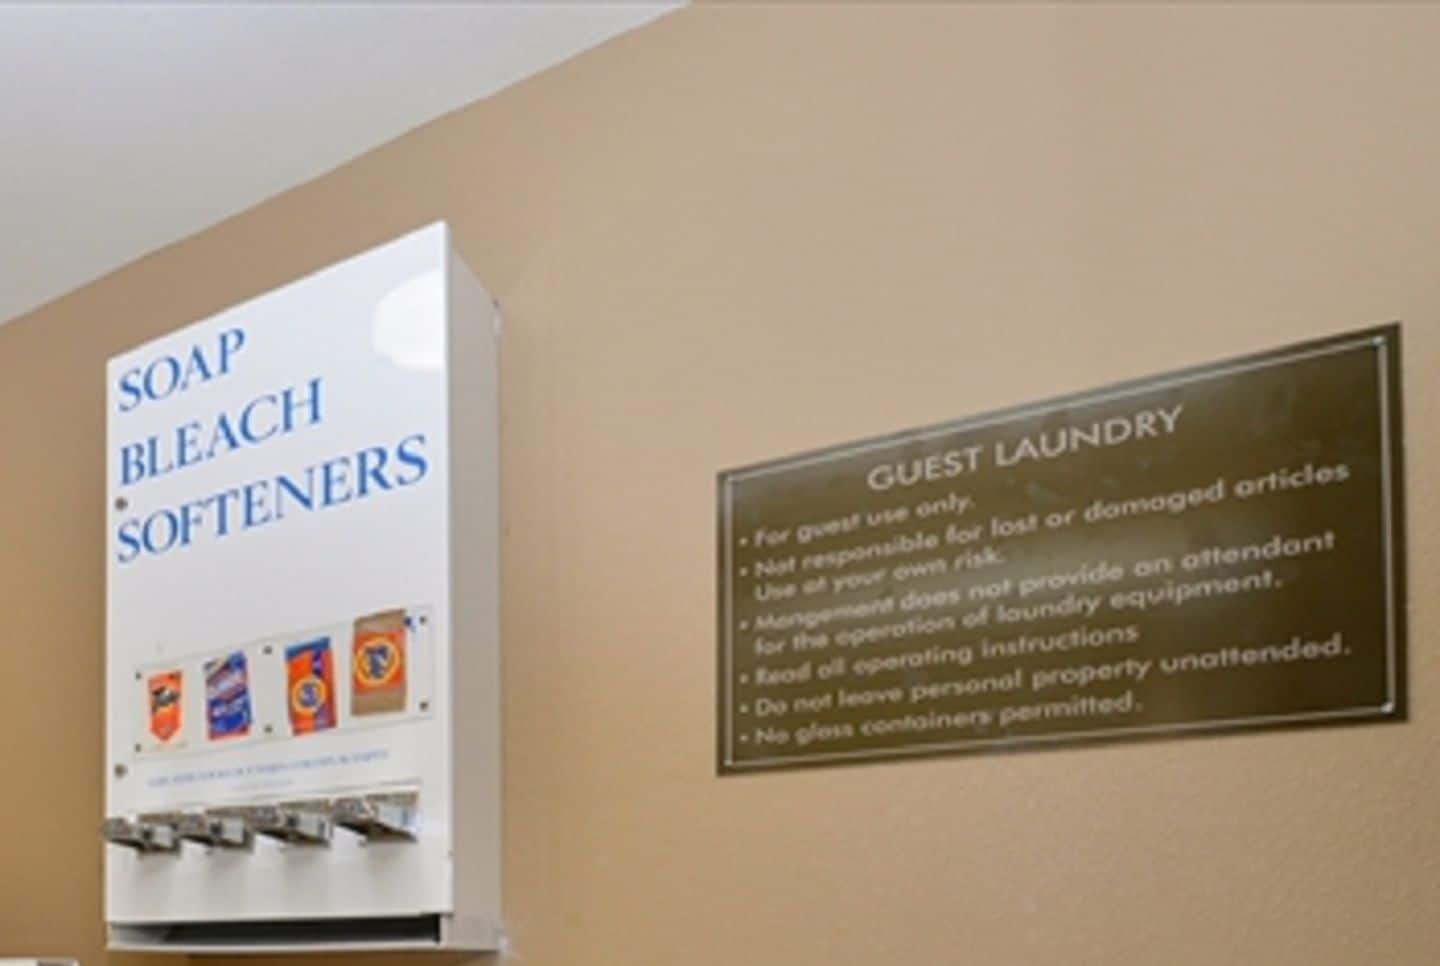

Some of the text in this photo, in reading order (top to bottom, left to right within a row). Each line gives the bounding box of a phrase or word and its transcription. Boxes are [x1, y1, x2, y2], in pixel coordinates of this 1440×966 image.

[117, 327, 247, 413] SOAP
[119, 377, 324, 488] BLEACH
[867, 404, 1183, 490] GUEST LAUNDRY
[116, 433, 429, 565] SOFTENERS
[754, 462, 1351, 577] Not responsible for lost or damaged articles
[754, 527, 791, 547] For
[796, 513, 860, 544] guest
[866, 507, 909, 526] use
[754, 581, 797, 600] Use
[803, 577, 828, 595] at
[833, 568, 887, 593] your
[893, 557, 947, 580] own
[754, 569, 1283, 656] for the operation of laundry equipment.
[900, 587, 960, 611] does
[968, 578, 1011, 600] not
[1019, 561, 1124, 597] provide
[1133, 557, 1172, 577] an
[1180, 529, 1335, 571] attendant
[755, 624, 1140, 686] Read all operating instructions
[755, 631, 1351, 717] Do not leave personal property unattended.
[755, 689, 1143, 745] No glass containers permitted.
